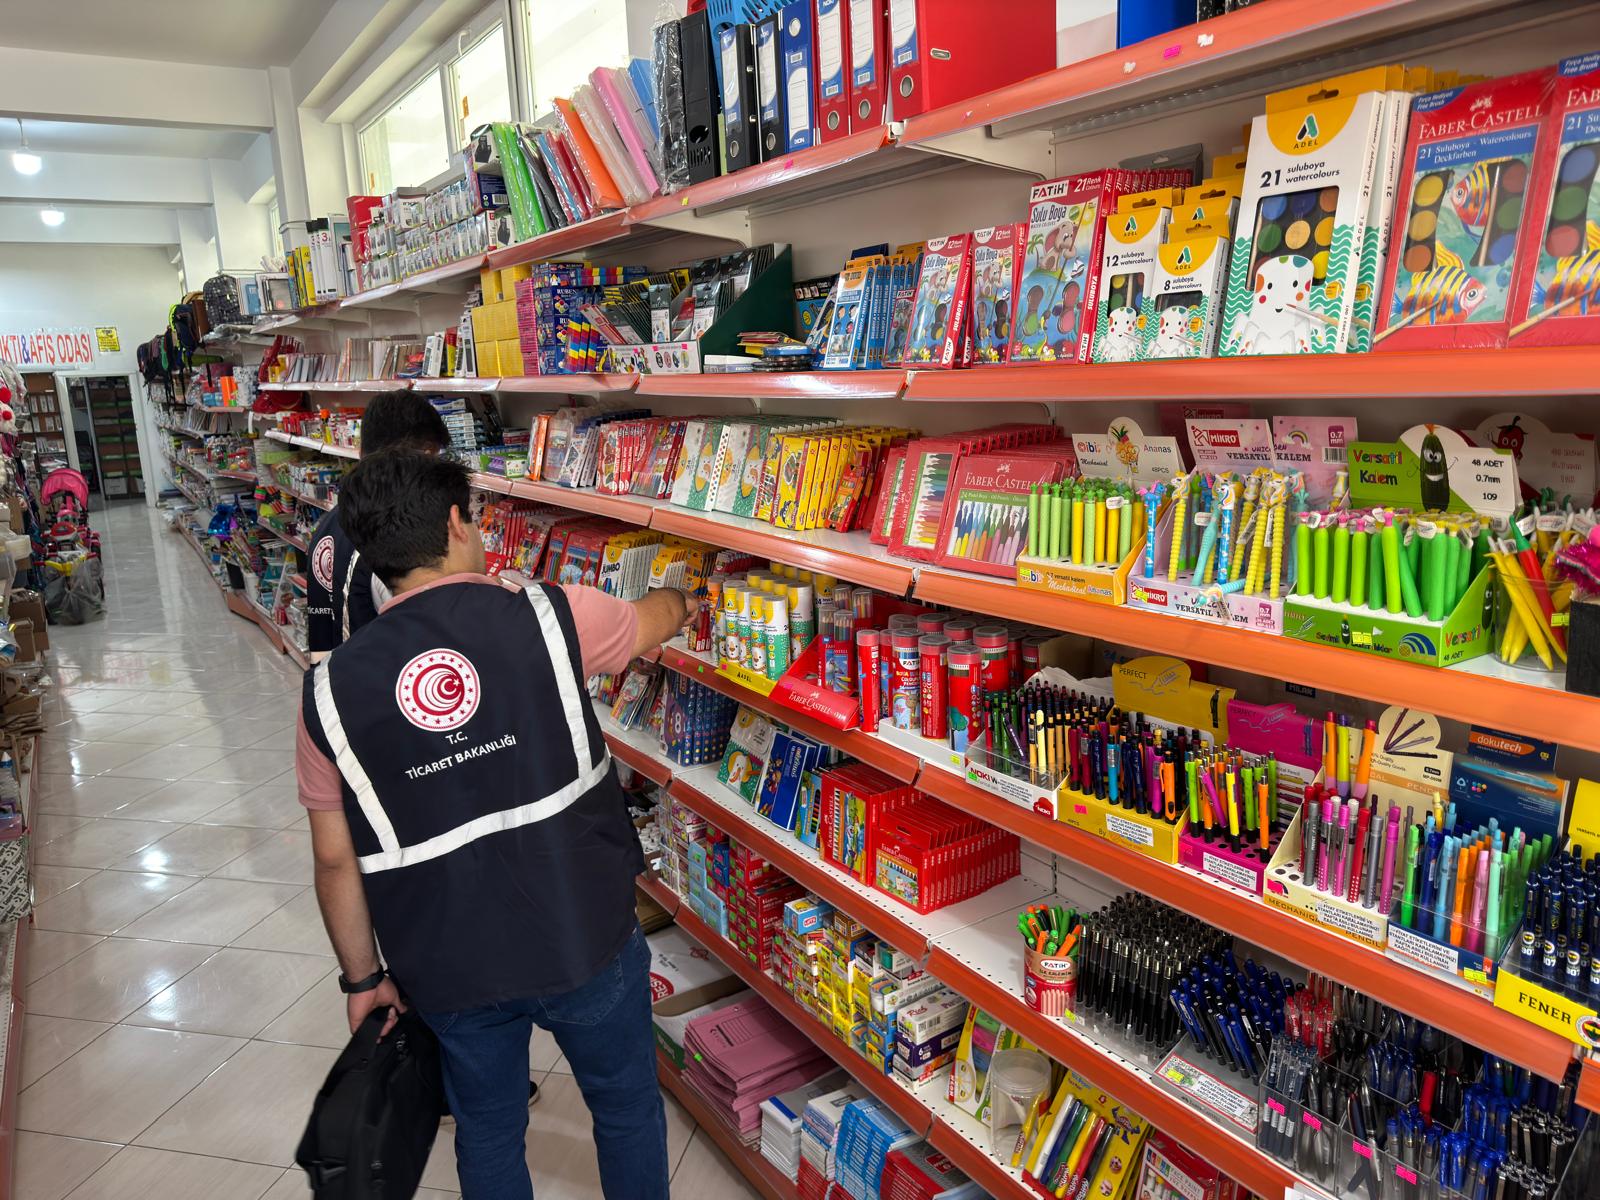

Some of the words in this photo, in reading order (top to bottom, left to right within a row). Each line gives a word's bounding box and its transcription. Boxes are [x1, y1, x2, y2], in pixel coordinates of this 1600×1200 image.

[1430, 99, 1444, 108] Brush
[1418, 105, 1544, 140] FABER-CASTELL
[1568, 116, 1581, 130] 21
[1587, 114, 1600, 124] Su
[1294, 139, 1318, 150] ADEL
[1420, 148, 1431, 160] 21
[1436, 142, 1470, 154] Suluboya
[1480, 132, 1532, 146] Watercolours
[1434, 150, 1476, 164] Deckfarben
[1260, 170, 1281, 188] 21
[1287, 160, 1325, 174] suluboya
[1286, 169, 1340, 184] watercolours
[1074, 178, 1088, 192] 21
[1032, 206, 1048, 224] Sulu
[1048, 204, 1066, 222] Boya
[1356, 215, 1364, 242] ADEL
[1382, 215, 1390, 242] ADEL
[1106, 254, 1118, 267] 12
[1121, 251, 1145, 260] suluboya
[1120, 258, 1154, 266] watercolours
[1164, 280, 1170, 290] 8
[1172, 276, 1194, 284] suluboya
[1172, 282, 1202, 291] watercolours
[1088, 276, 1098, 310] SULUBOYA
[58, 334, 93, 364] ODASI
[1144, 444, 1172, 453] Ananas
[1276, 453, 1311, 462] KALEM
[1352, 449, 1402, 466] Versatil
[1359, 470, 1398, 486] Kalem
[1476, 474, 1500, 484] 0.7mm
[1482, 492, 1498, 500] 109
[602, 563, 620, 574] JUMBO
[1446, 624, 1481, 648] Versatil
[1450, 650, 1464, 658] ADET
[1119, 668, 1148, 680] PERFECT
[446, 731, 468, 744] T.C.
[1478, 735, 1522, 754] dokutech
[405, 756, 453, 780] TİCARET
[454, 734, 517, 764] BAKANLIĞI
[970, 767, 990, 782] NOKI
[1345, 930, 1381, 948] PENCIL
[906, 1006, 928, 1018] Rich
[1518, 992, 1572, 1024] FENER
